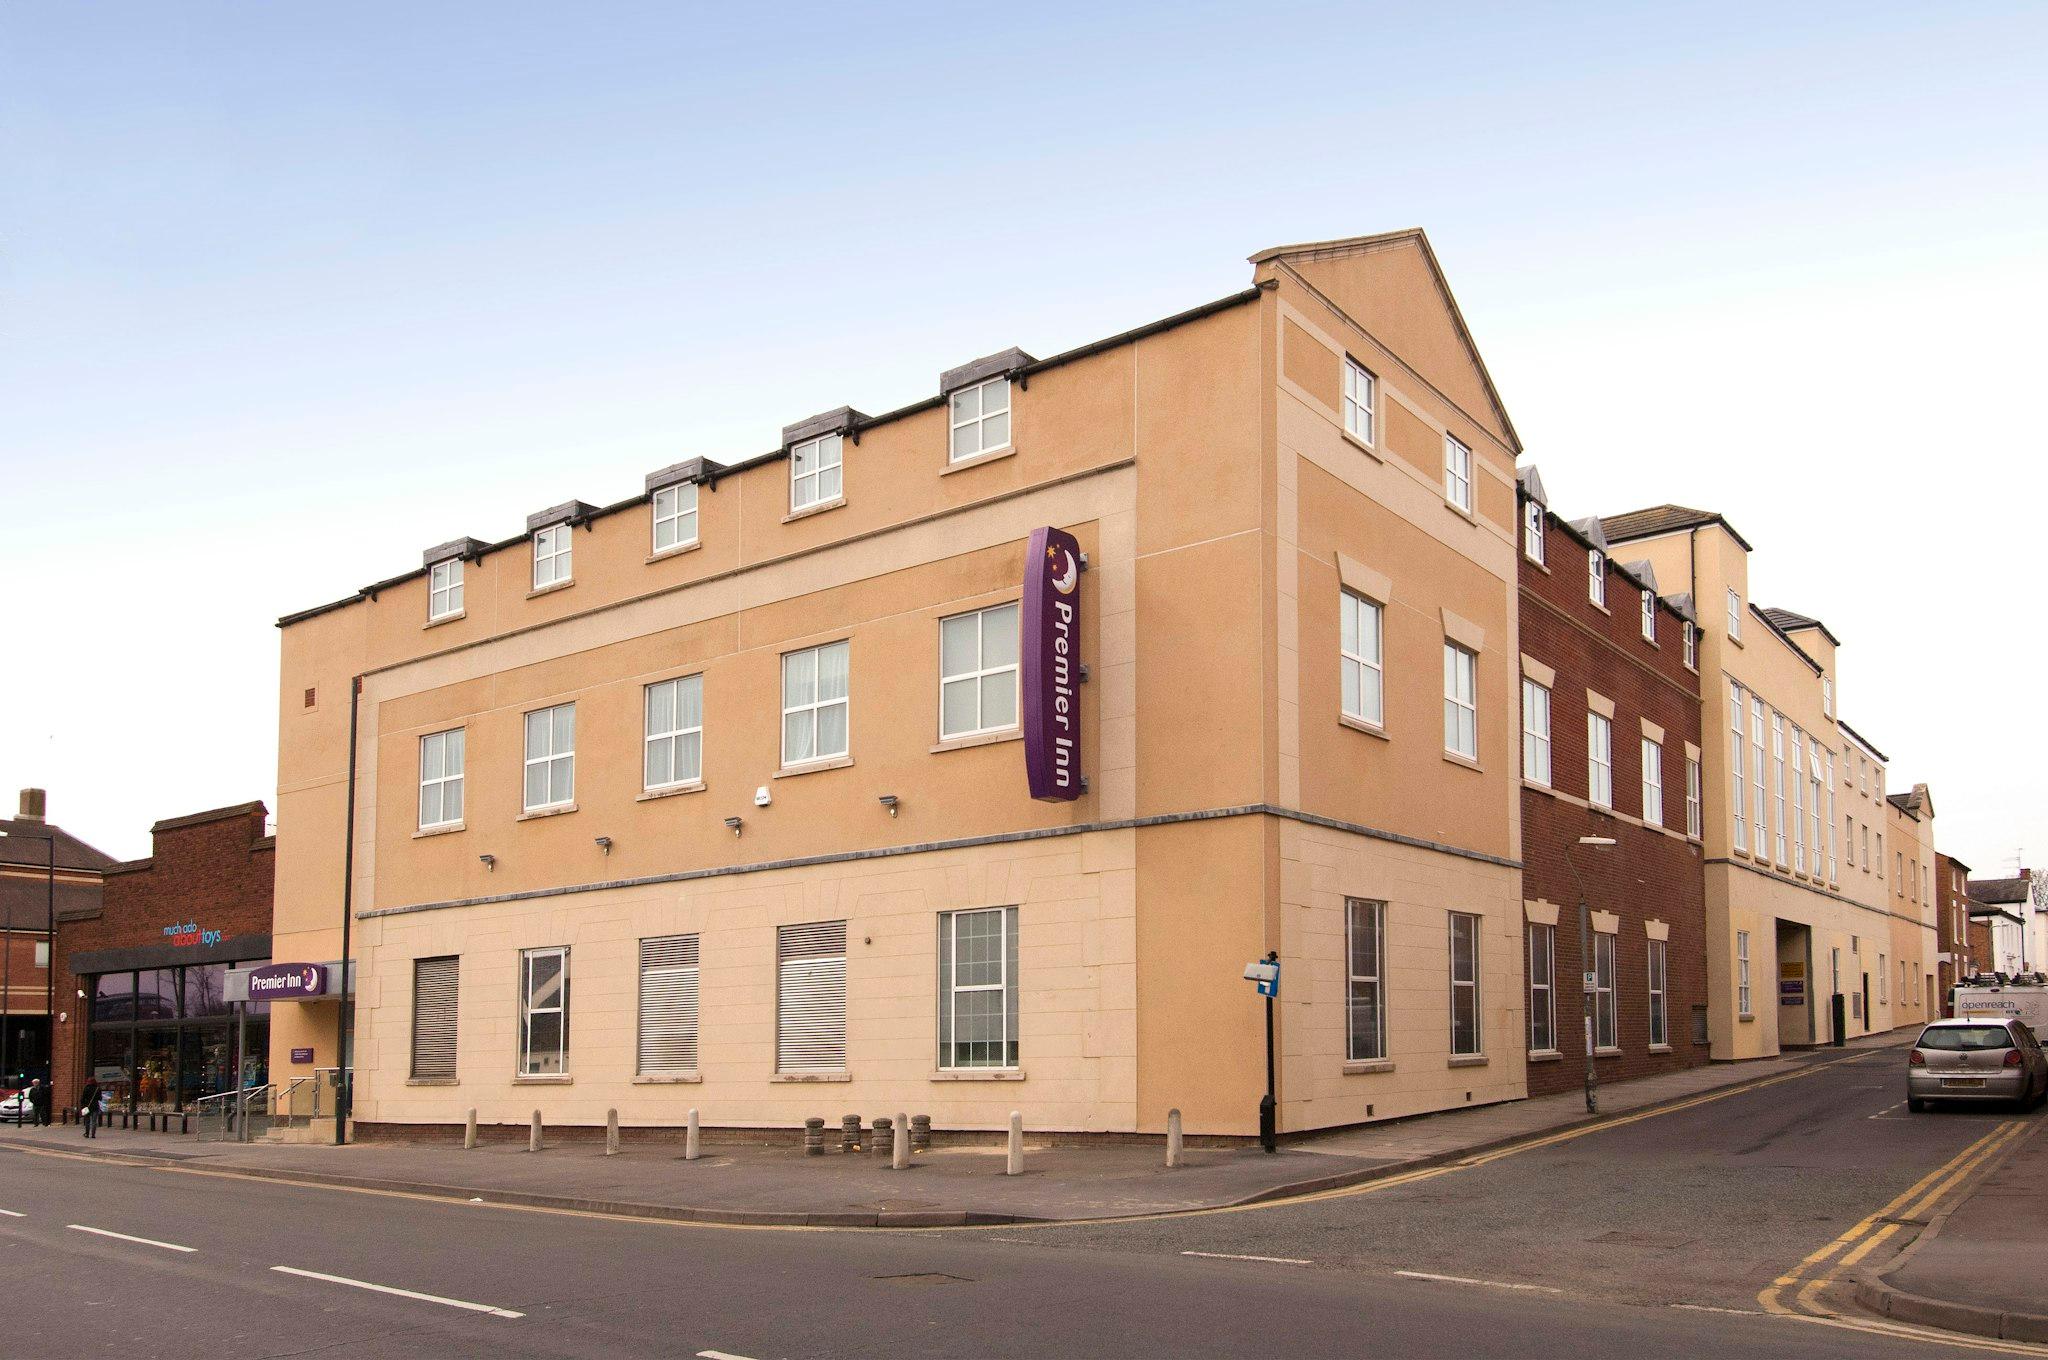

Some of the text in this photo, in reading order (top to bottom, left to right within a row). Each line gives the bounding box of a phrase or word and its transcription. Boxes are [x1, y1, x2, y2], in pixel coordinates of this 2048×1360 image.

[1055, 600, 1073, 787] Premier Inn
[163, 918, 197, 935] much ado
[173, 930, 202, 947] about
[202, 928, 221, 948] toys
[251, 973, 301, 990] Premier Inn
[1961, 1000, 2015, 1010] openreach
